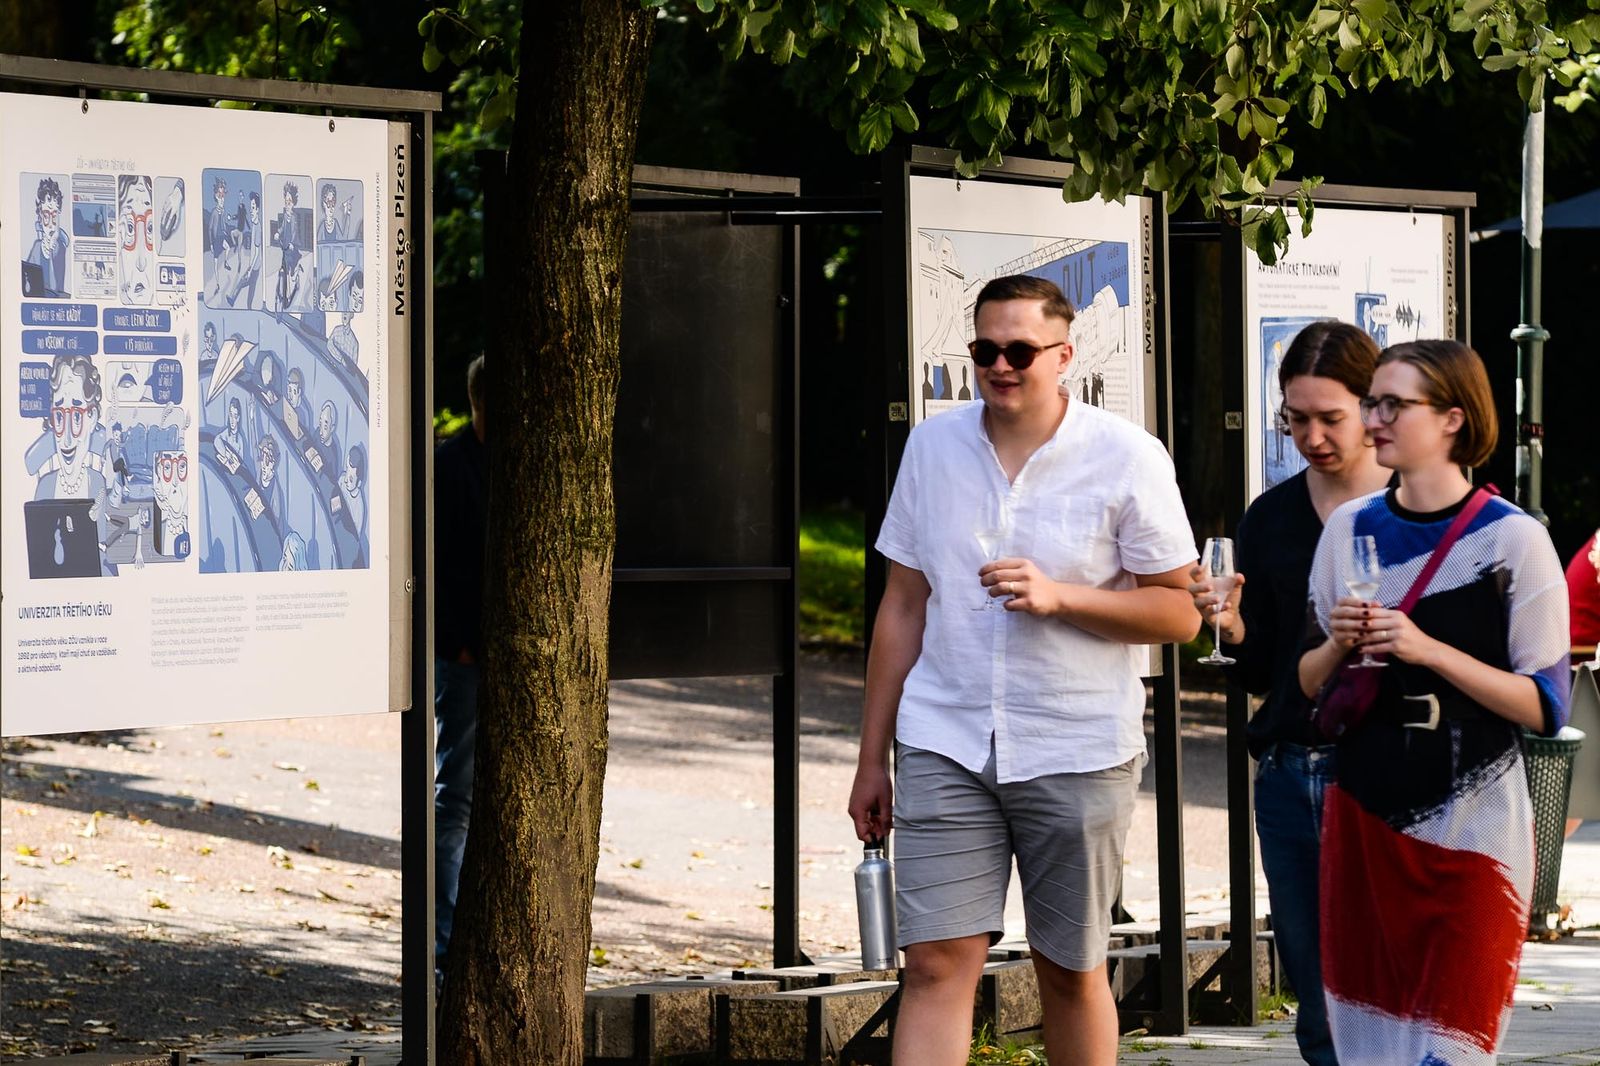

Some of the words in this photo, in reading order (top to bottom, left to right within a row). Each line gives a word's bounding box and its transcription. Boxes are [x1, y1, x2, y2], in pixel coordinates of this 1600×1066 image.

[394, 144, 405, 218] Plzeň
[394, 228, 405, 316] Město
[18, 605, 61, 620] UNIVERZITA
[62, 602, 92, 618] TŘETÍHO
[93, 601, 113, 617] VĚKU
